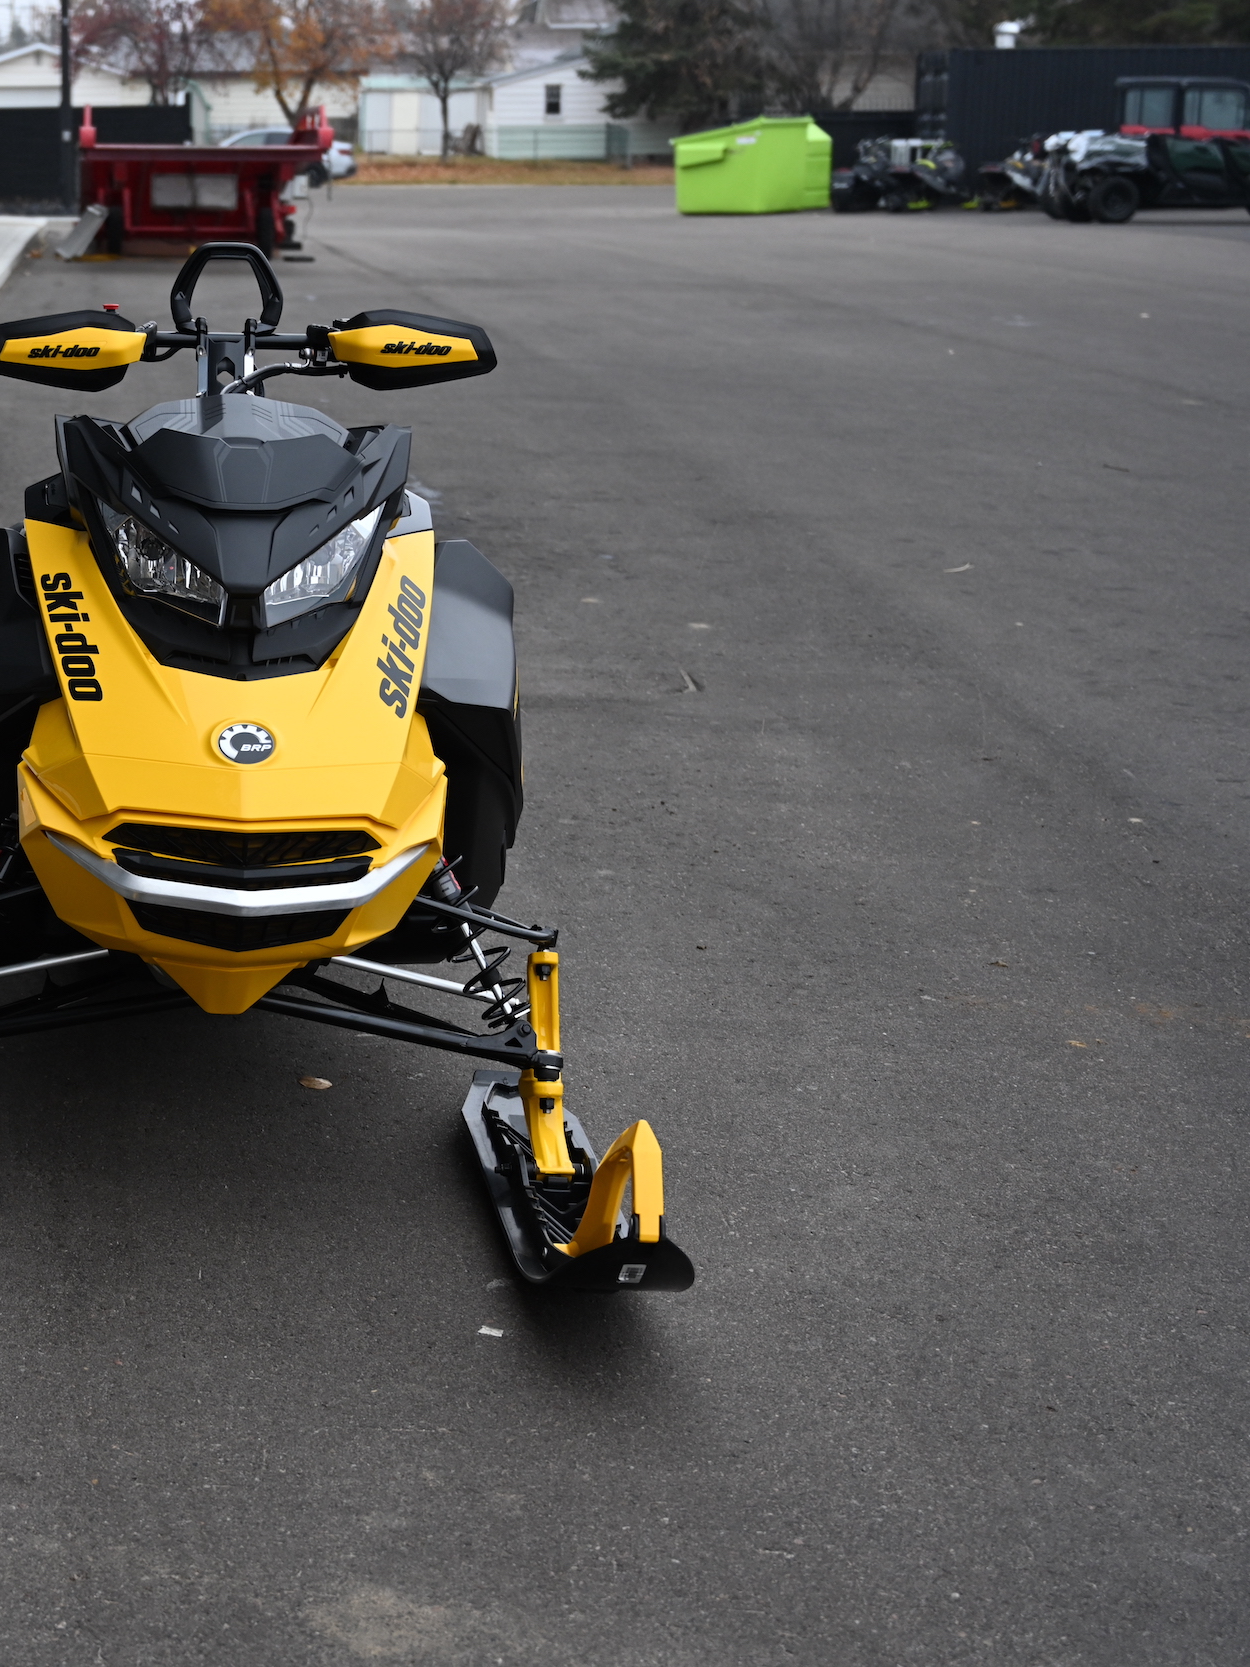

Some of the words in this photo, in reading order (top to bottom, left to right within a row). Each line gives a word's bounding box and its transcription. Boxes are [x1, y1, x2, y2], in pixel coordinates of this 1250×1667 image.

[28, 345, 101, 358] ski-doo
[380, 341, 452, 355] ski-doo
[40, 572, 104, 702] ski-doo
[376, 575, 426, 719] ski-doo
[240, 743, 272, 752] BRP
